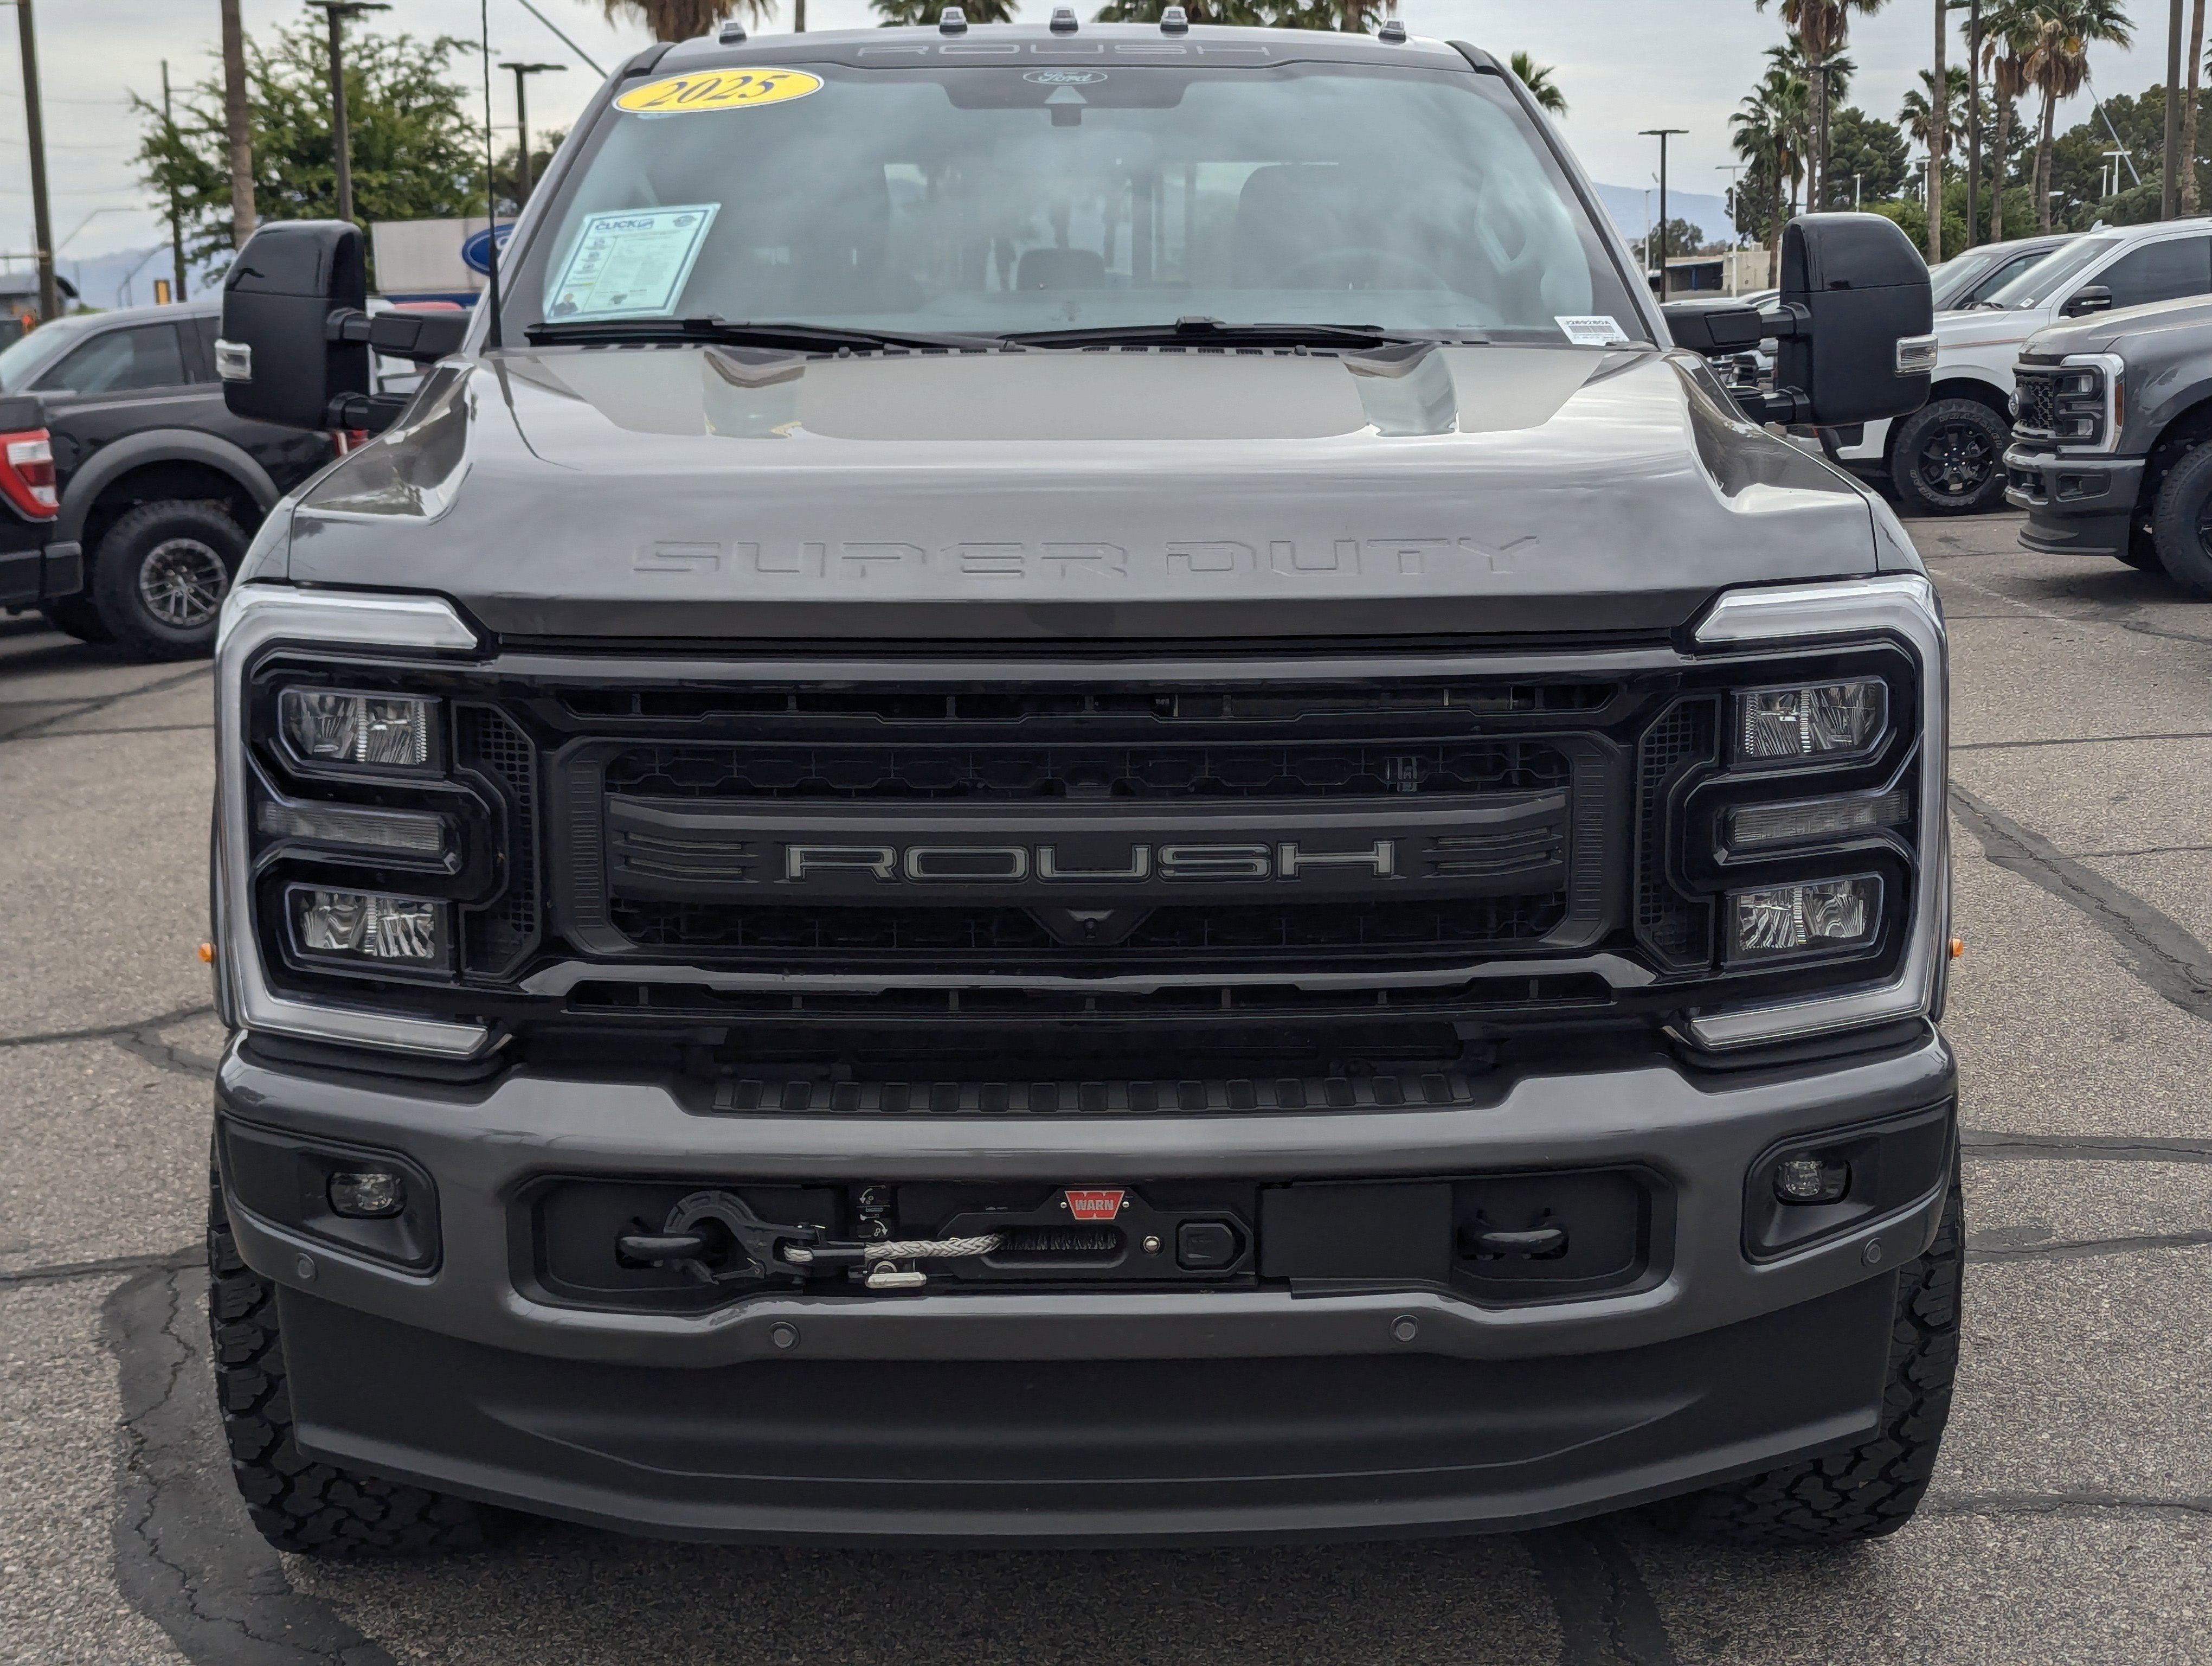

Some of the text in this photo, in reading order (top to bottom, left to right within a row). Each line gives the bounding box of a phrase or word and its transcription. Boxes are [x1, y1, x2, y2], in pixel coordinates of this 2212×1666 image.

[857, 44, 1271, 57] ROUSH
[1038, 71, 1092, 82] Ford
[638, 75, 791, 108] 2025
[632, 535, 1539, 578] SUPER DUTY
[783, 839, 1394, 883] ROUSH
[1075, 1199, 1114, 1211] WARN
